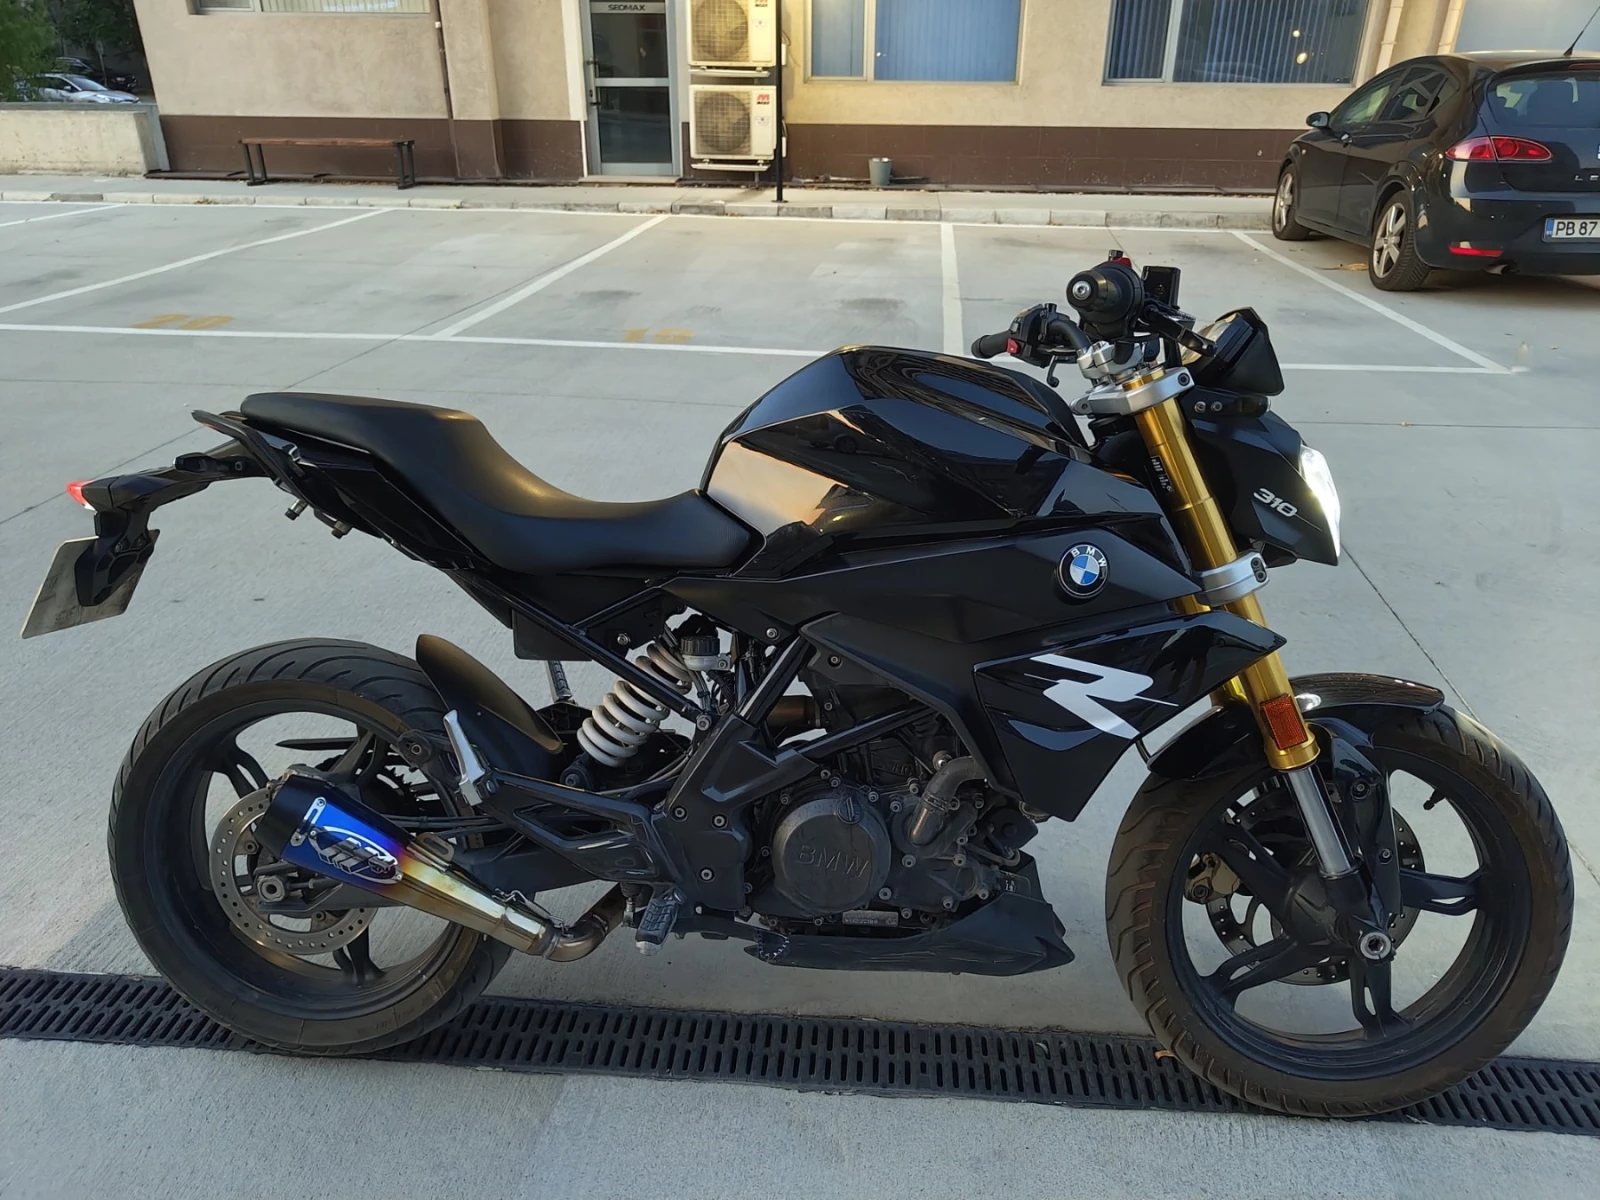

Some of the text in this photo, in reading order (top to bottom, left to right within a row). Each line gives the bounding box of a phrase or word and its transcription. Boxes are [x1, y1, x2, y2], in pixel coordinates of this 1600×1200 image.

[1555, 221, 1598, 236] PB 87
[1253, 488, 1298, 517] 310
[1070, 546, 1107, 567] BMW
[1028, 653, 1156, 740] R
[797, 845, 869, 877] BMW
